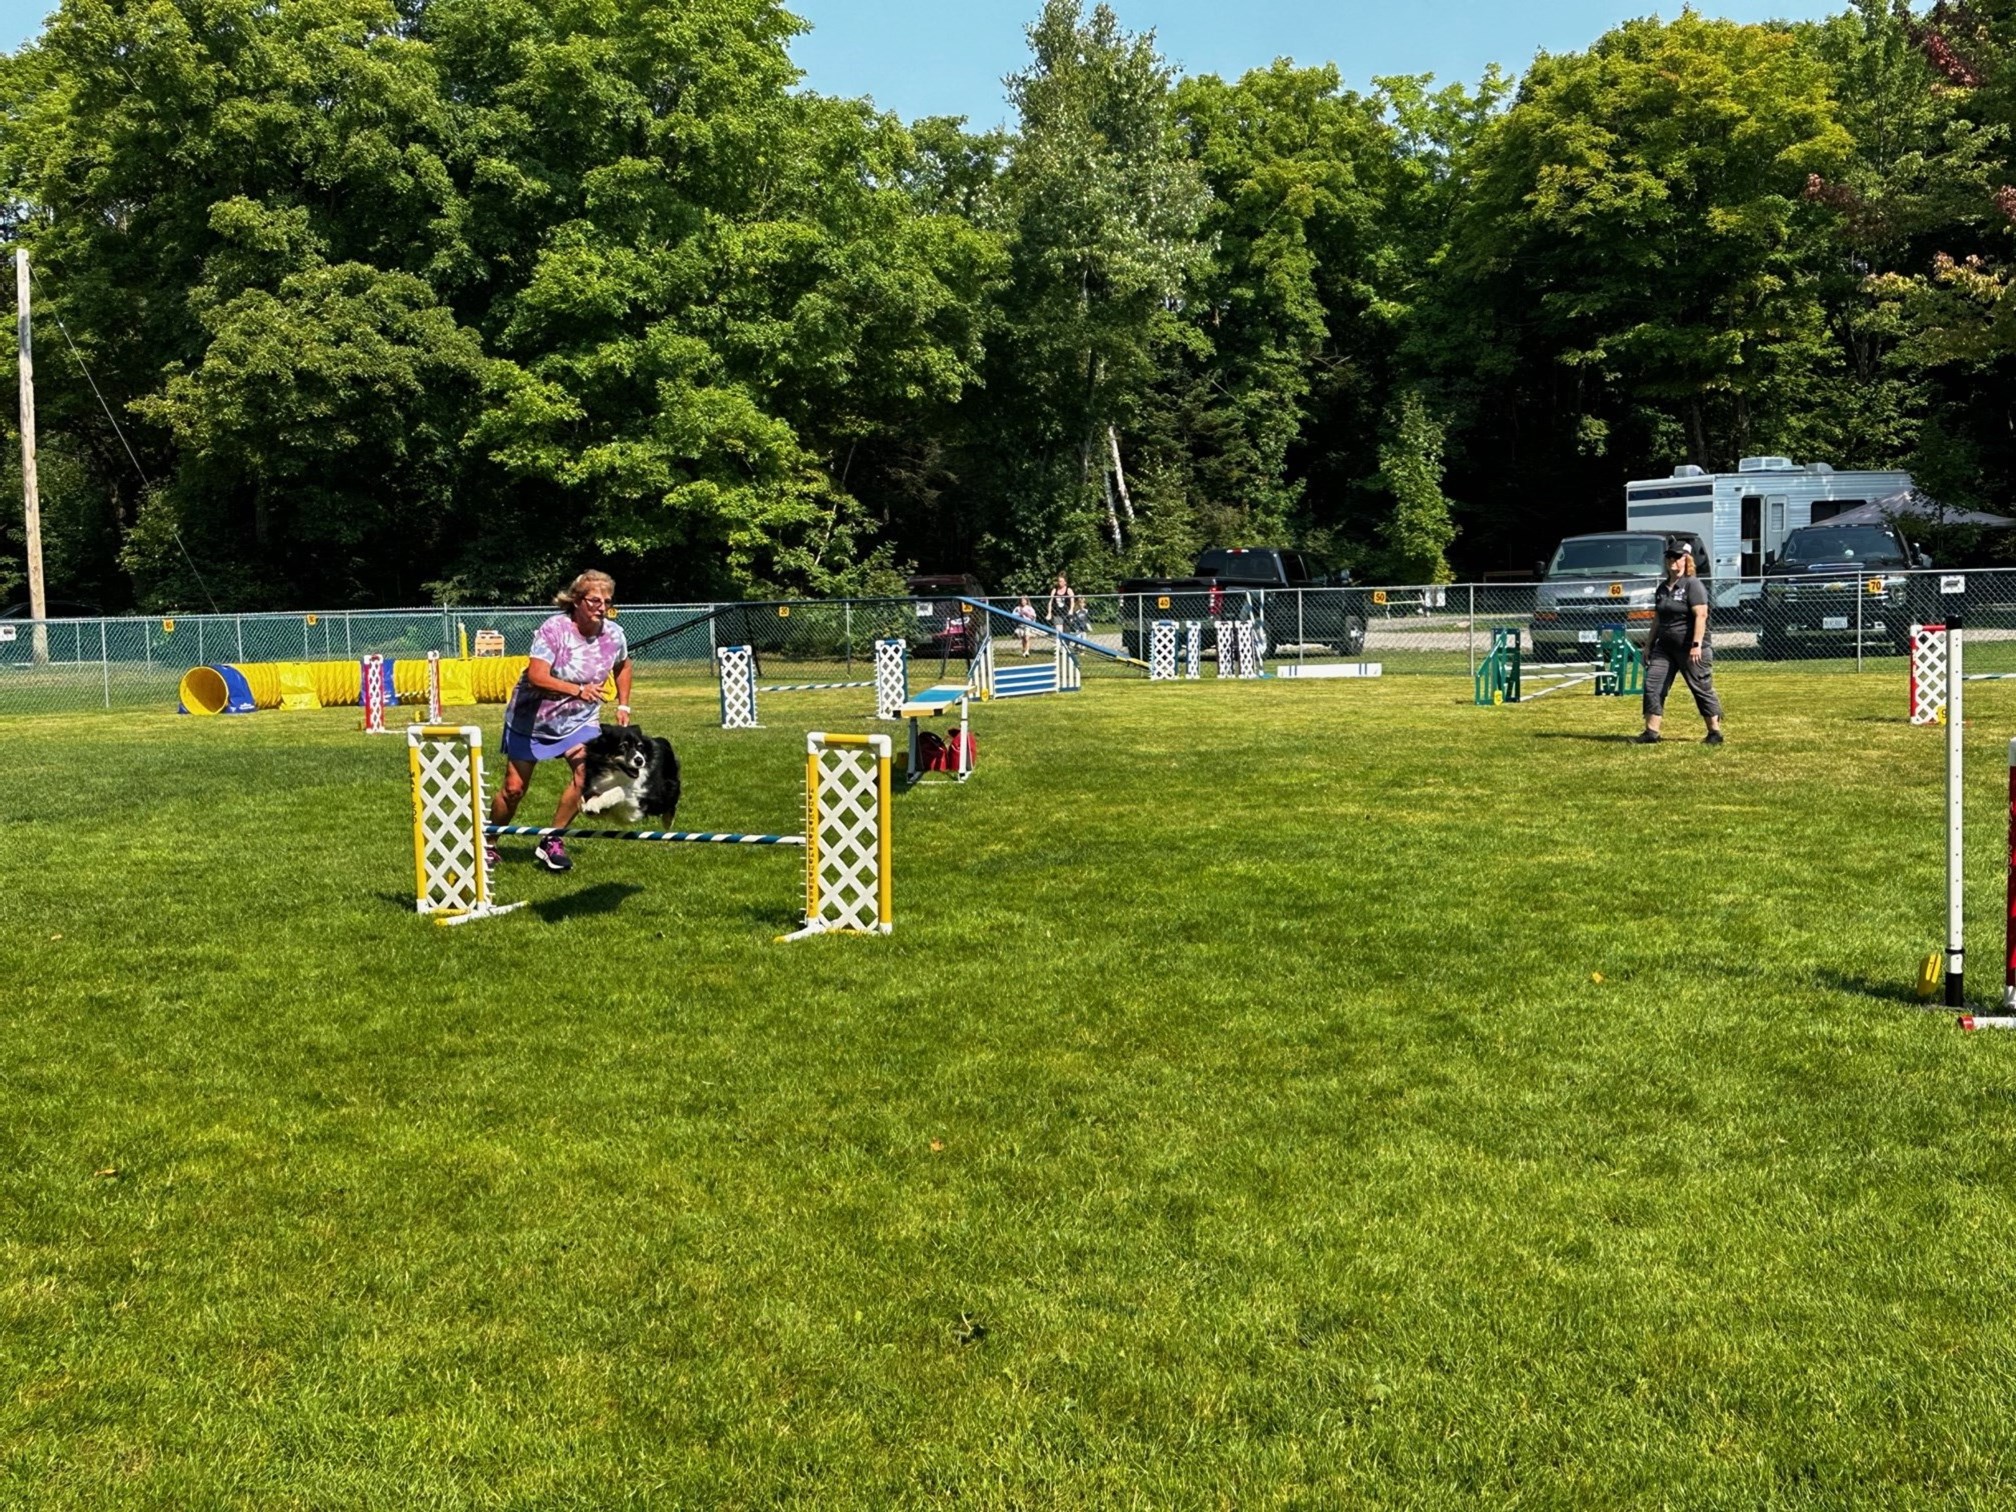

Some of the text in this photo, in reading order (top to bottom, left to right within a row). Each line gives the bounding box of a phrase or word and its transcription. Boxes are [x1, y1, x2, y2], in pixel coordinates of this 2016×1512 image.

[1870, 581, 1881, 590] 70
[1611, 586, 1621, 595] 60
[1375, 593, 1385, 602] 50
[1160, 599, 1169, 607] 40
